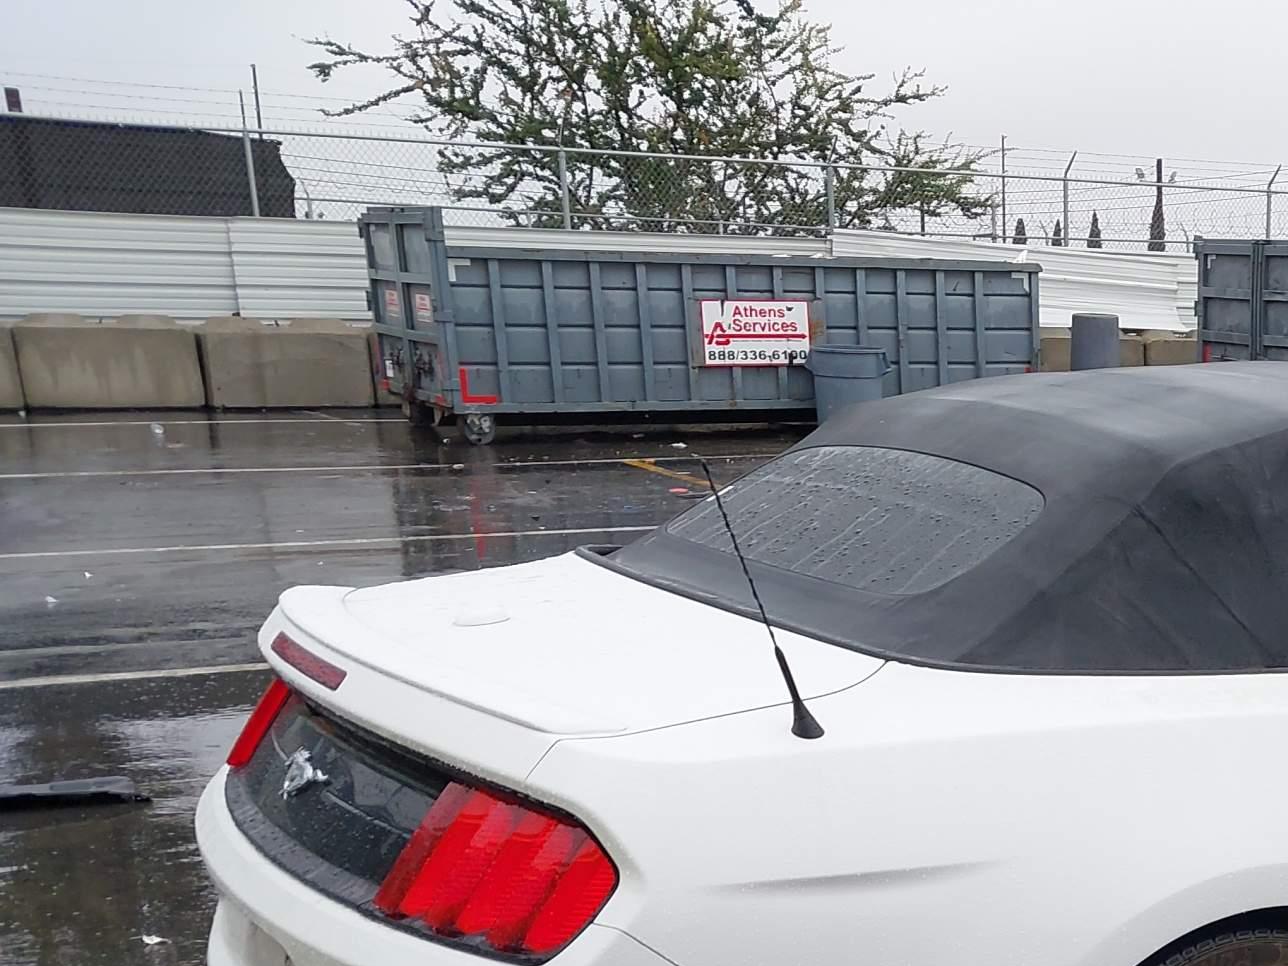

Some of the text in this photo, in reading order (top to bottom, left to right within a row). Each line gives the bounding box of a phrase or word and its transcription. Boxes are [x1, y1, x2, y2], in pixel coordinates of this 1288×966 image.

[732, 305, 785, 318] Athens
[732, 319, 798, 332] Services
[708, 349, 807, 361] 888/336-6100
